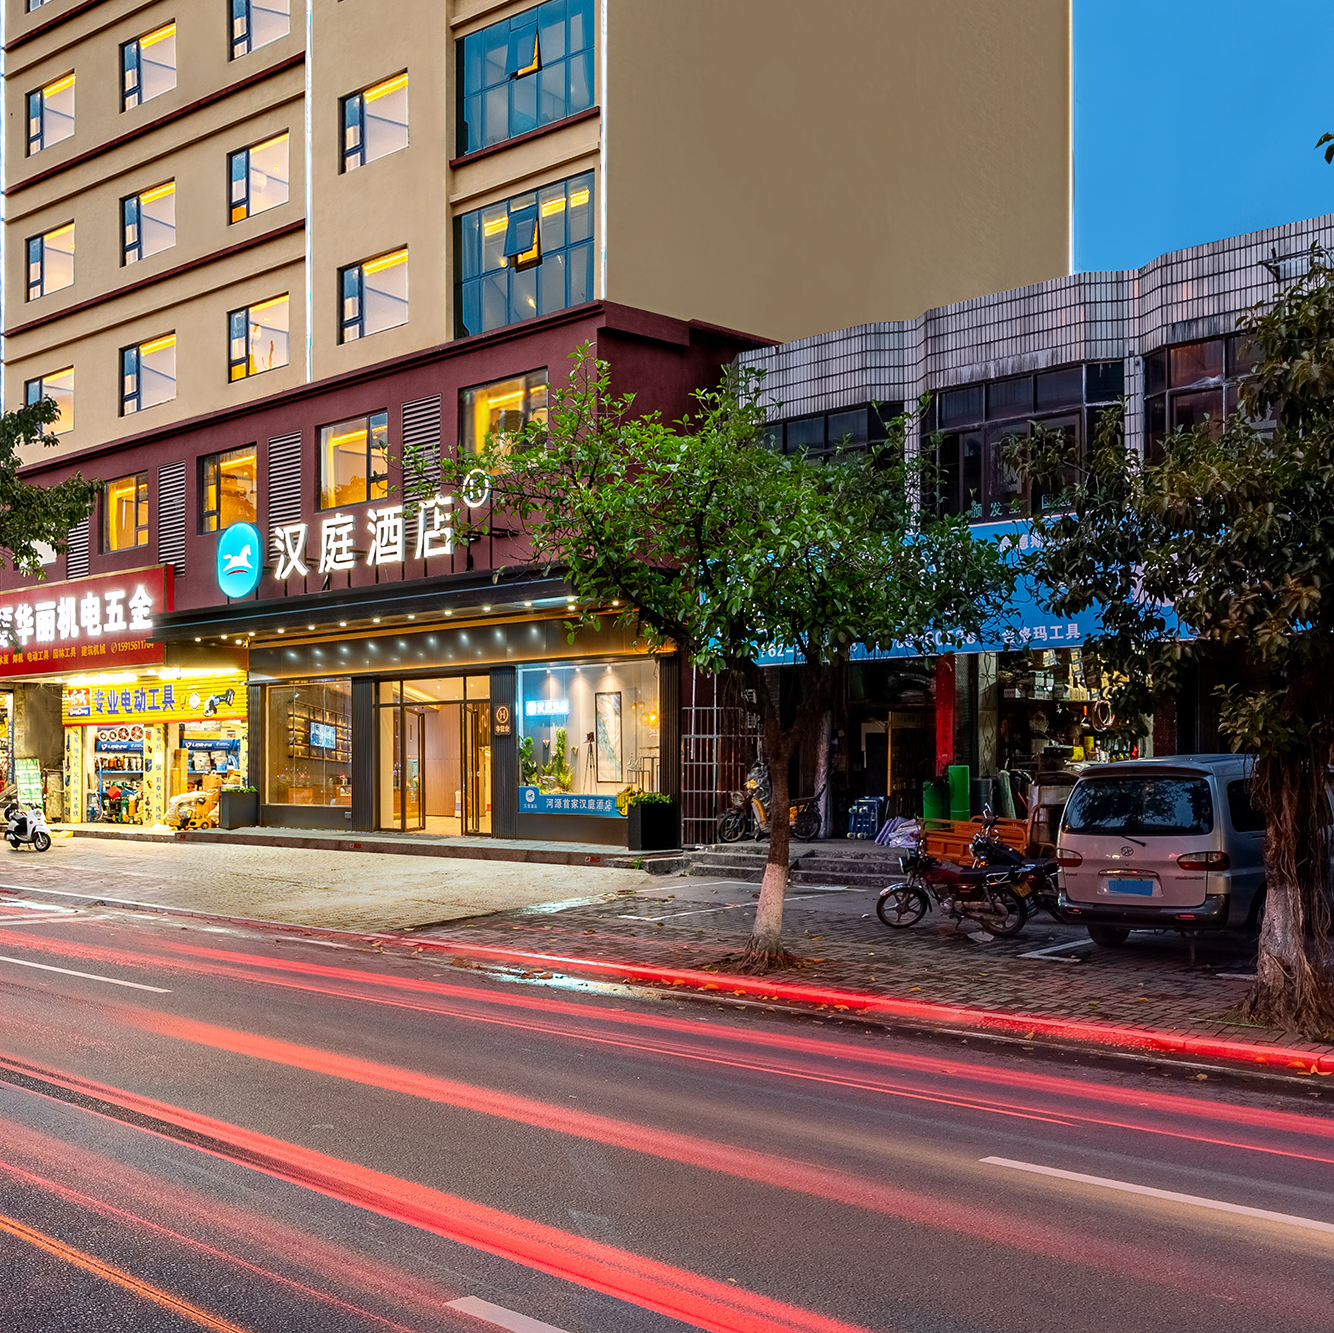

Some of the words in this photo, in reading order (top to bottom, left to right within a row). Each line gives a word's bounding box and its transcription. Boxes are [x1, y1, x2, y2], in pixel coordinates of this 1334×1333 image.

[274, 494, 455, 581] 汉庭酒店
[26, 649, 49, 663] 电动工具
[53, 647, 76, 659] 园林工具
[93, 684, 176, 715] 专业电动工具
[546, 798, 613, 811] 河源首家汉庭酒店
